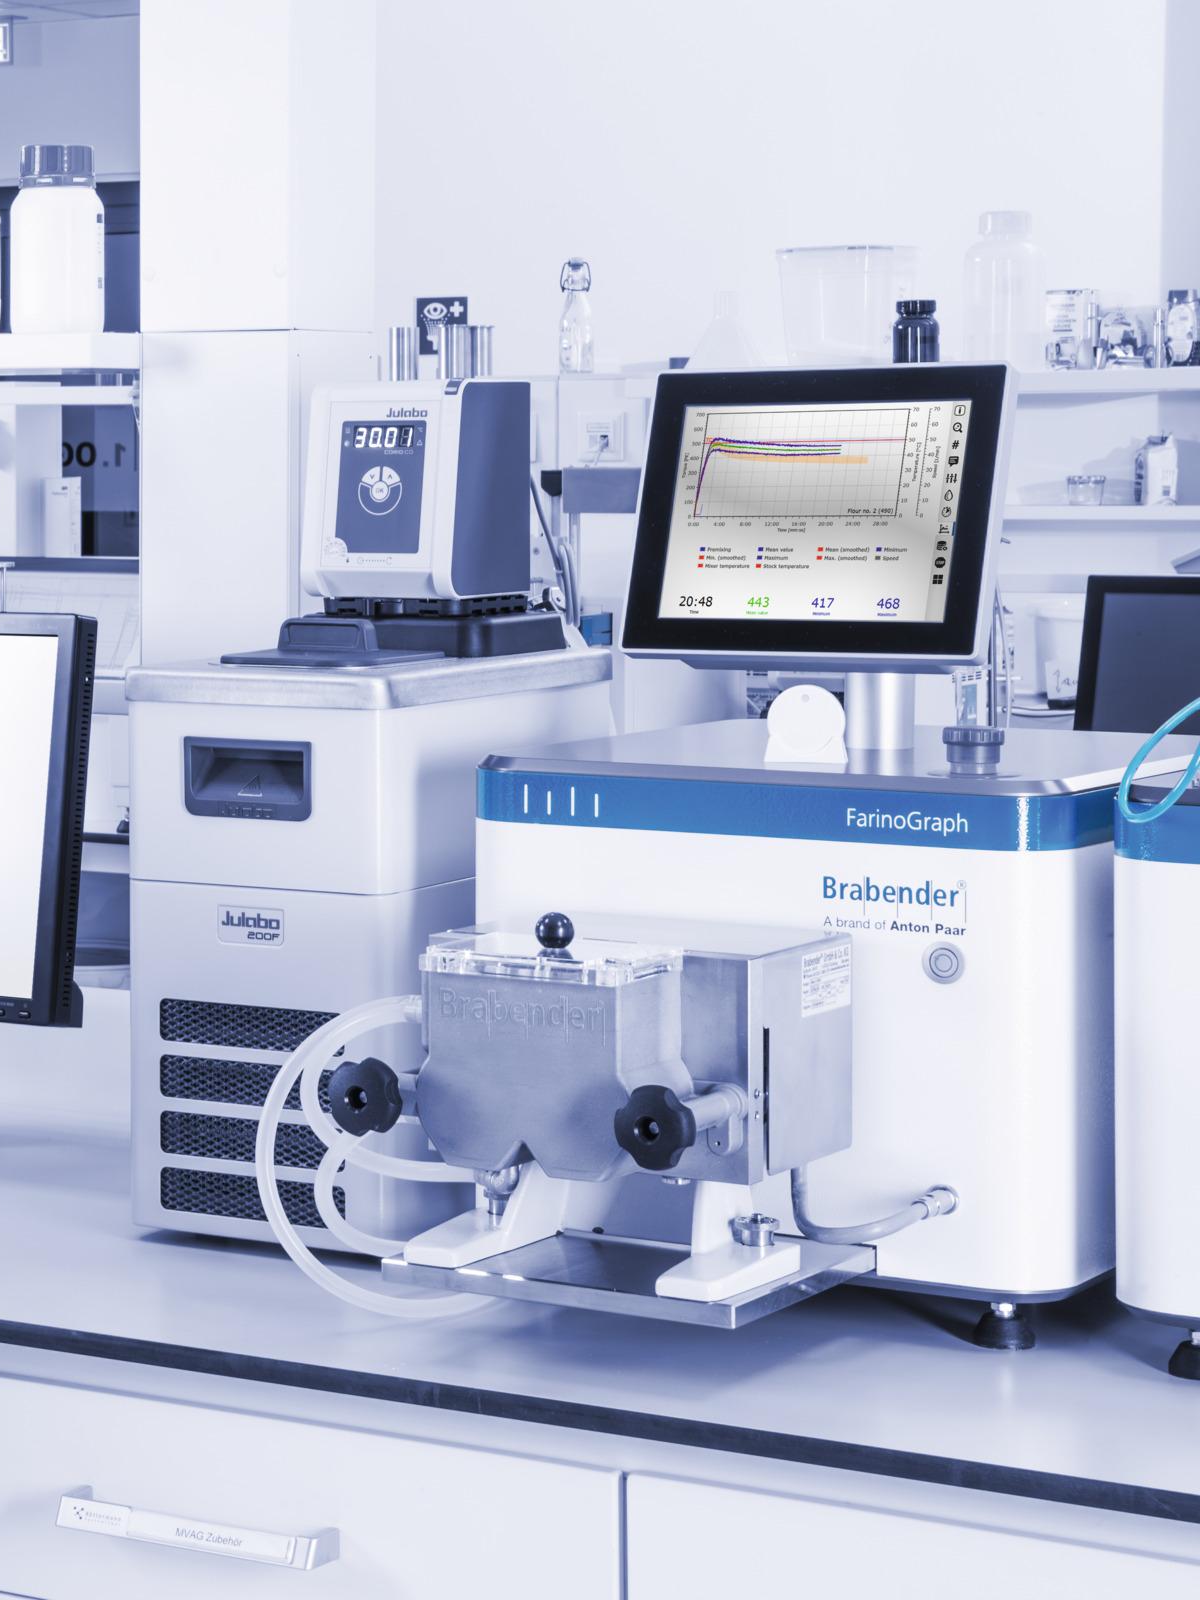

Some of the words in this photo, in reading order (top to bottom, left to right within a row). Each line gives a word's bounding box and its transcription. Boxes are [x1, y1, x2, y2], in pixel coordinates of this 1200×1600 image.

[386, 407, 428, 418] Julabo
[355, 427, 413, 448] 30.01
[912, 453, 921, 482] Temperature
[679, 595, 713, 607] 20:48
[747, 596, 770, 608] 443
[811, 597, 835, 609] 417
[876, 598, 900, 609] 468
[846, 807, 968, 837] FarinoGraph
[221, 910, 280, 930] Julabo
[823, 916, 833, 927] A
[836, 916, 870, 929] brand
[874, 920, 886, 930] of
[890, 920, 930, 933] Anton
[934, 923, 967, 936] Paar
[247, 931, 280, 941] 200F
[175, 1527, 204, 1541] MVAG
[205, 1533, 242, 1548] Zubehör
